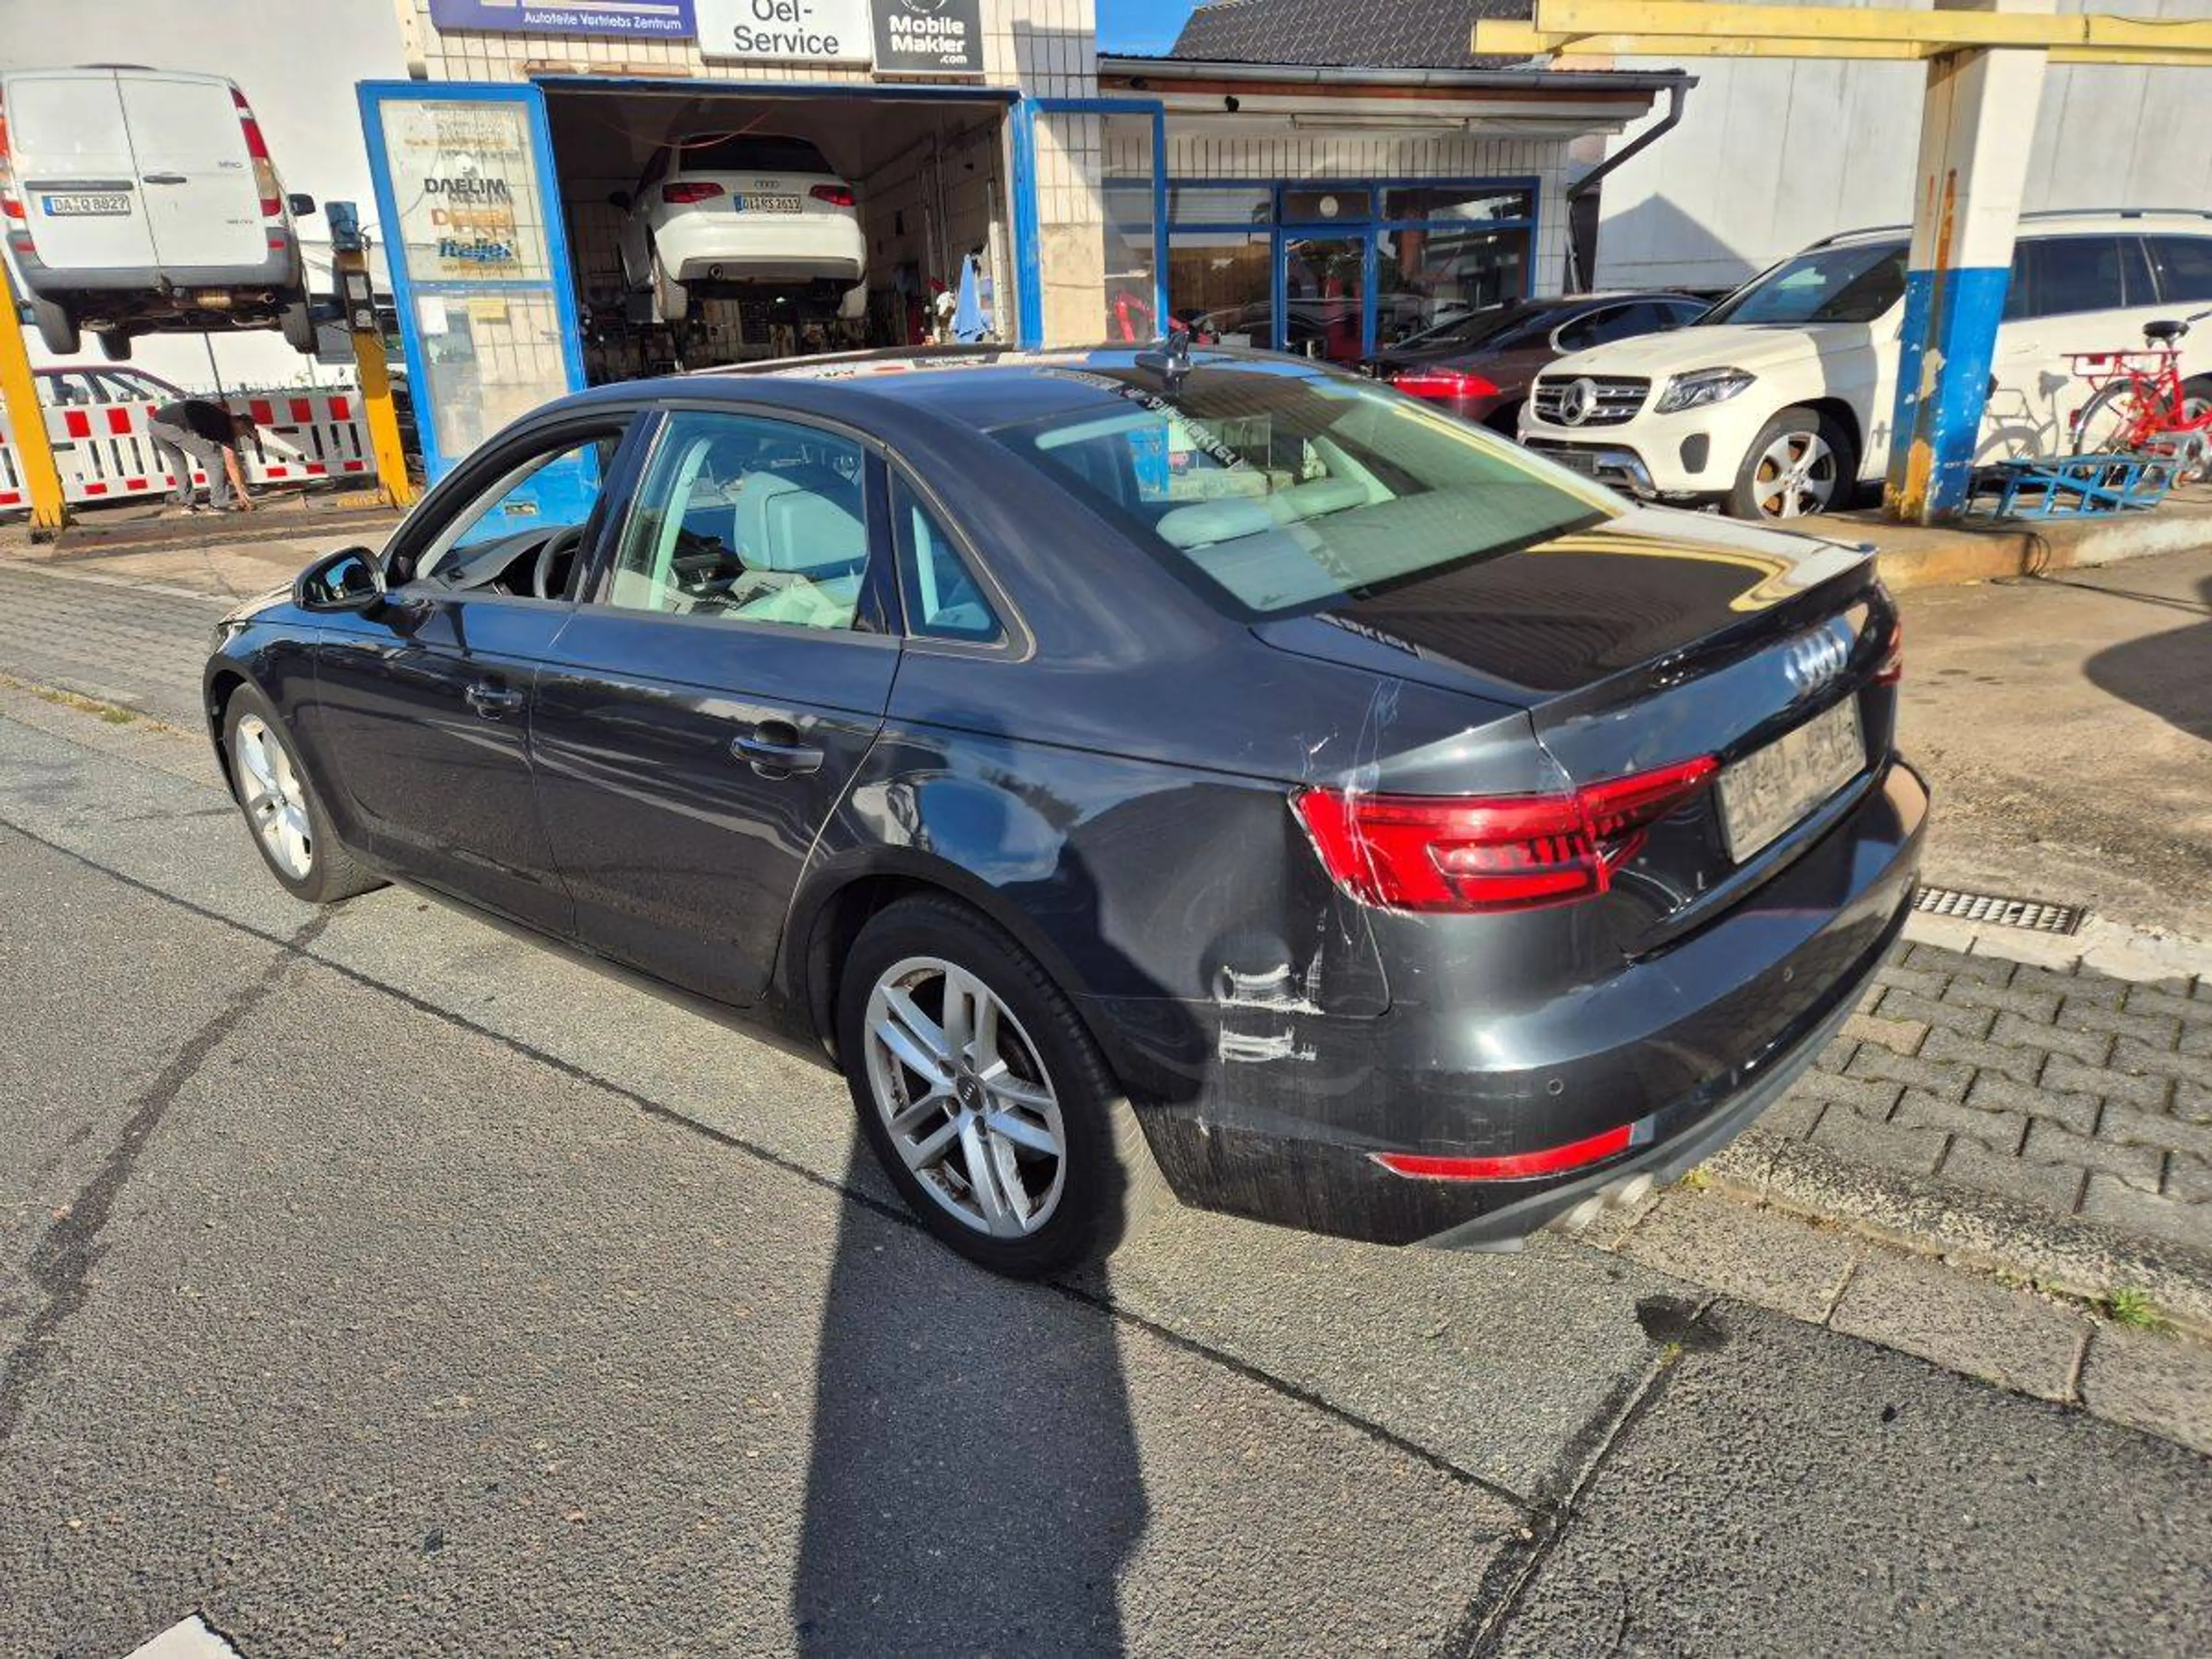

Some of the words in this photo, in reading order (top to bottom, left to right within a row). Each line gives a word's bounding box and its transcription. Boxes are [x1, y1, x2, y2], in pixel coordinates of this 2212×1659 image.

[752, 0, 812, 22] Oel-
[525, 12, 578, 25] Autoteile
[579, 13, 631, 28] Vertriebs
[634, 16, 681, 30] Zentrum
[888, 14, 965, 34] Mobile
[733, 25, 839, 54] Service
[891, 34, 966, 53] Makler
[941, 55, 967, 65] .com
[424, 178, 507, 195] DAELIM
